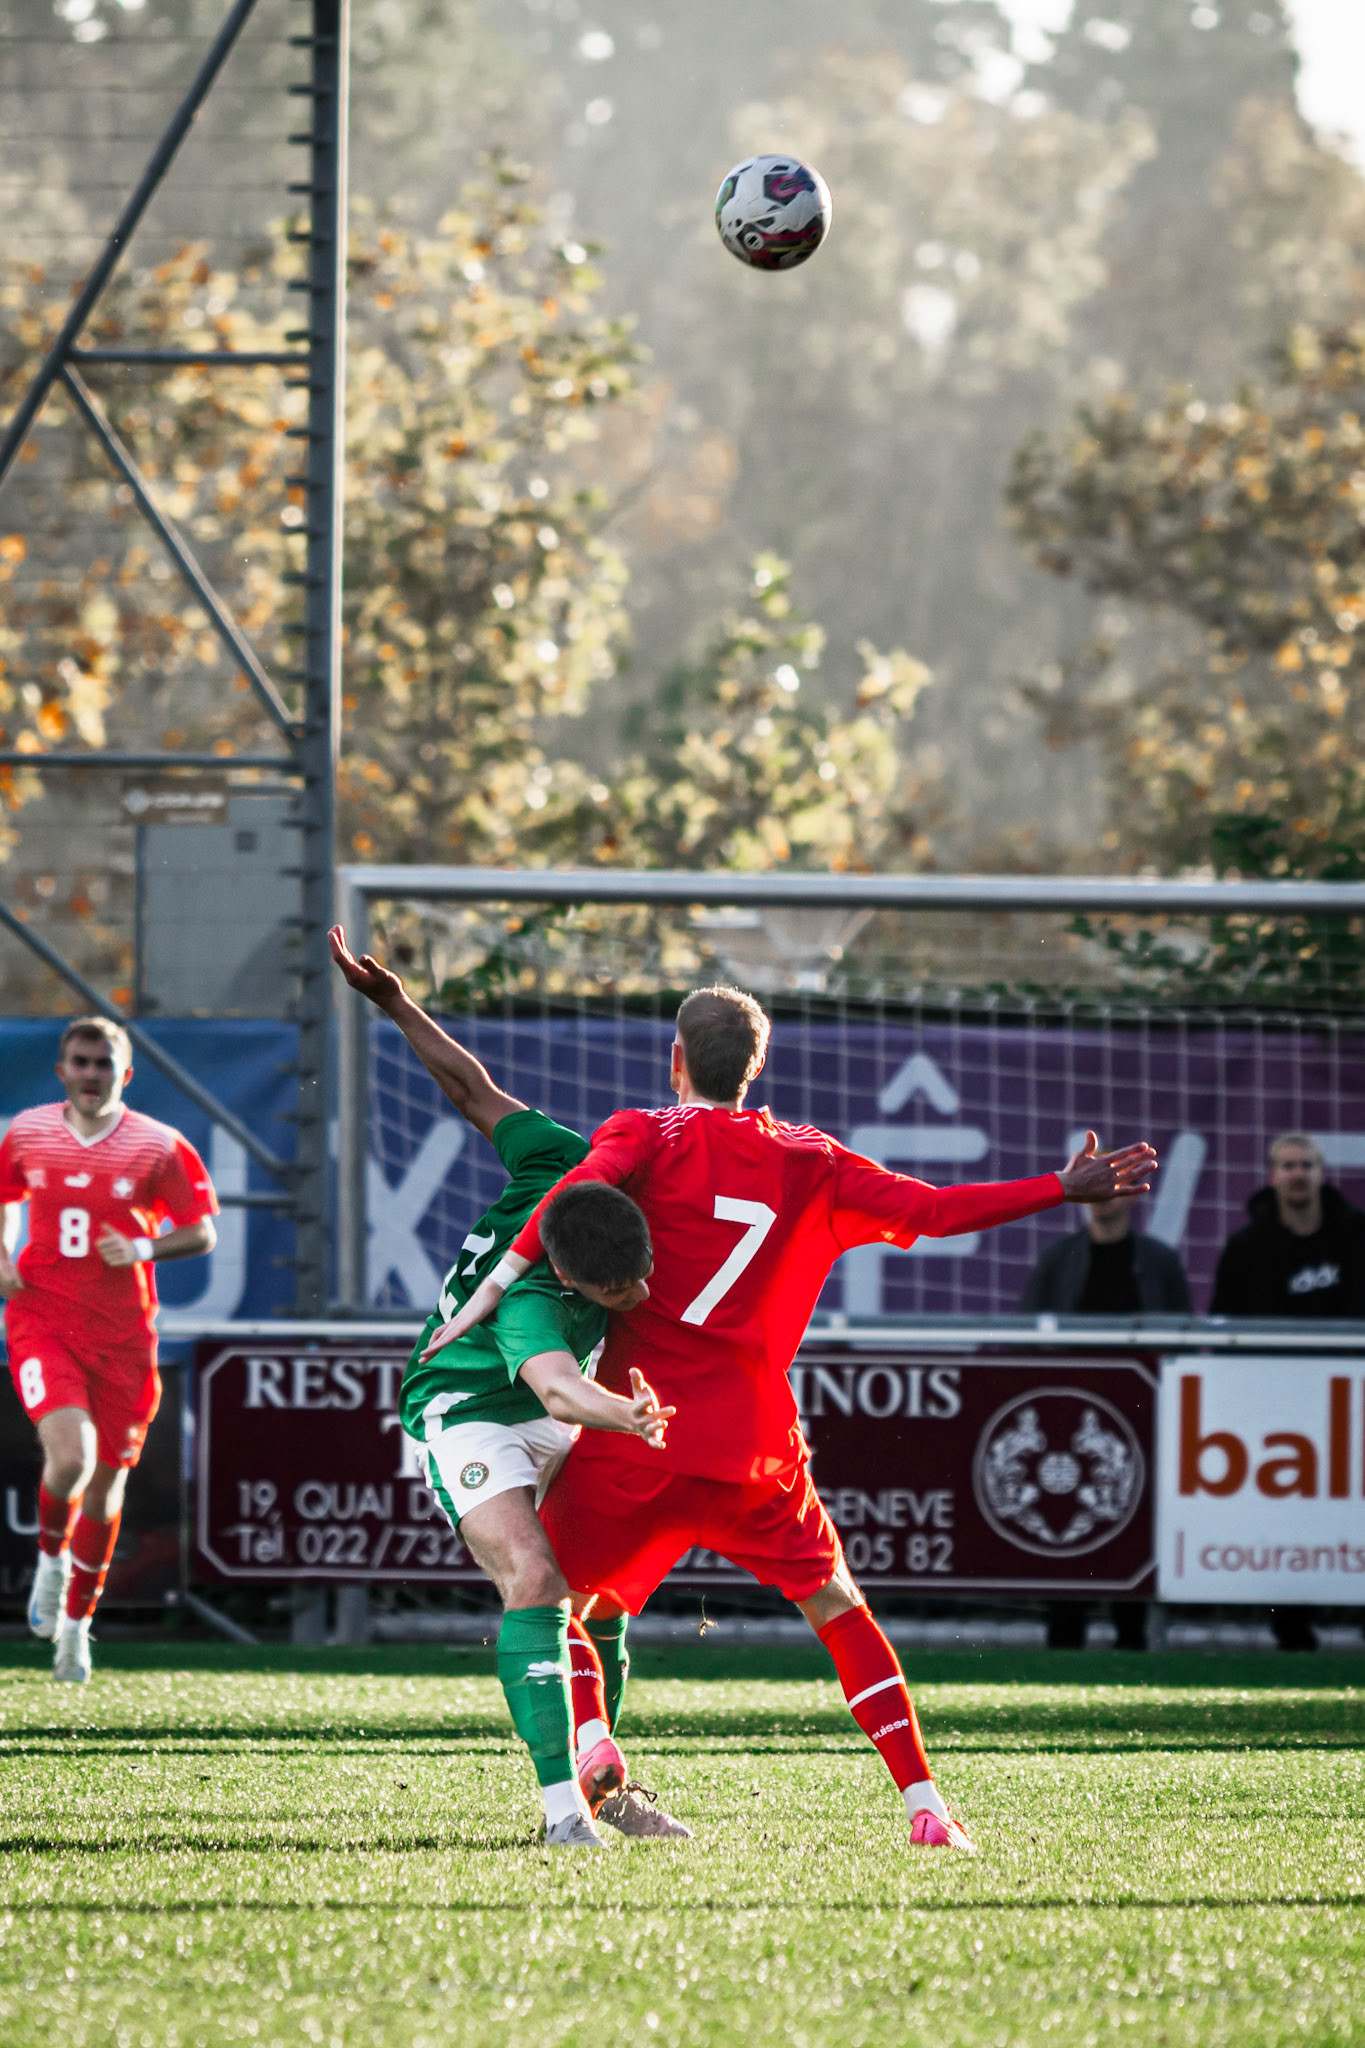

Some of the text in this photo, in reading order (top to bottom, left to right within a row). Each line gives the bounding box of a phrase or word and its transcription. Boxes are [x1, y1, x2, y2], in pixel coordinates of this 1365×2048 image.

[59, 1208, 90, 1258] 8
[680, 1195, 778, 1326] 7
[19, 1357, 46, 1409] 8
[244, 1359, 963, 1418] REST INOIS
[1178, 1373, 1365, 1498] bal
[294, 1481, 394, 1520] QUAI
[906, 1532, 954, 1572] 82
[871, 1718, 910, 1741] suisse
